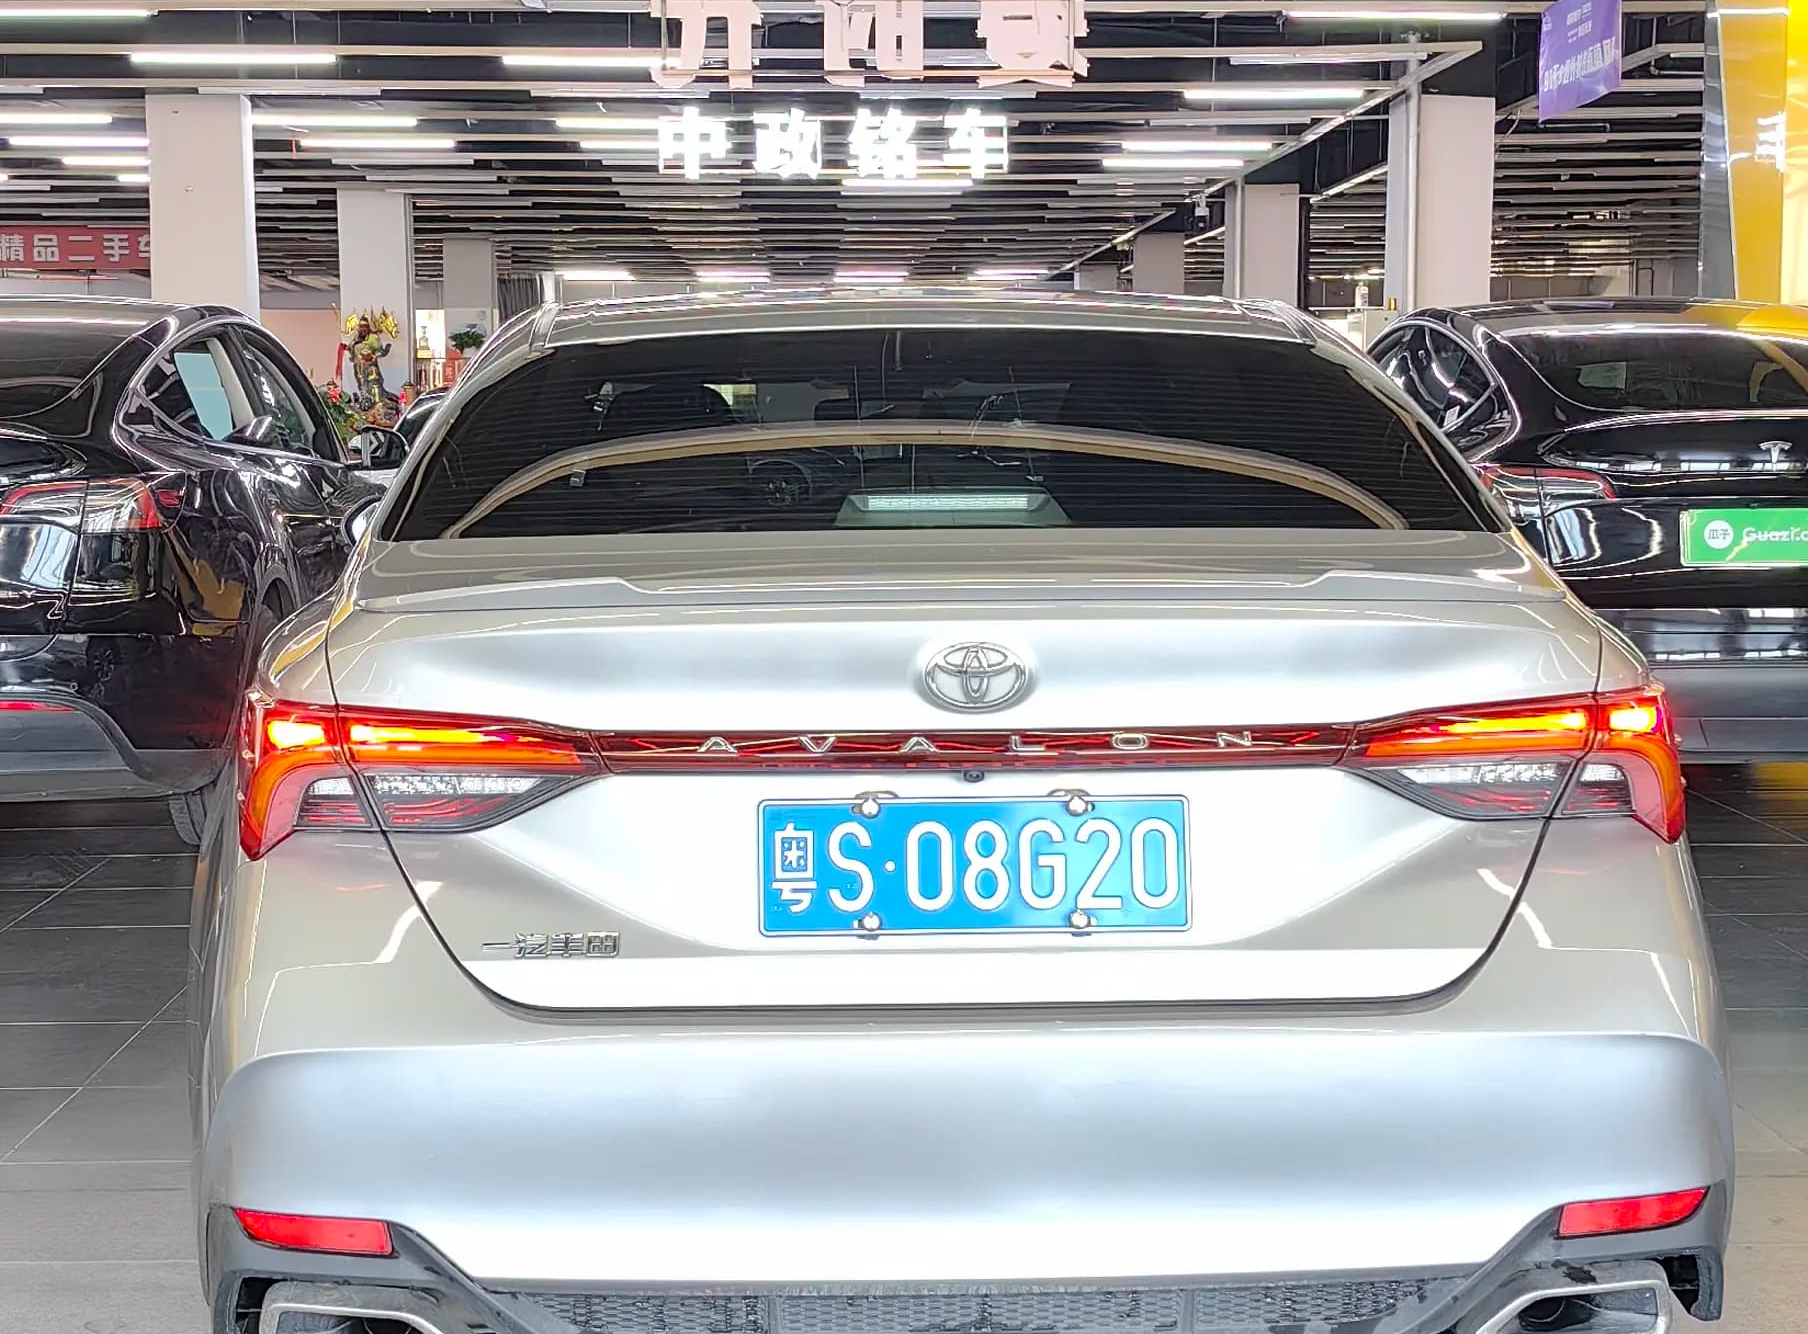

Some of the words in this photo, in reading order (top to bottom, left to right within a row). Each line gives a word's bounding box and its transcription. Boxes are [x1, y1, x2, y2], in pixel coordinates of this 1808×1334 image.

[1708, 528, 1731, 540] 瓜子
[699, 730, 1251, 754] AVALON
[770, 818, 1180, 913] 粤S·08G20
[481, 931, 620, 959] 一汽丰田
